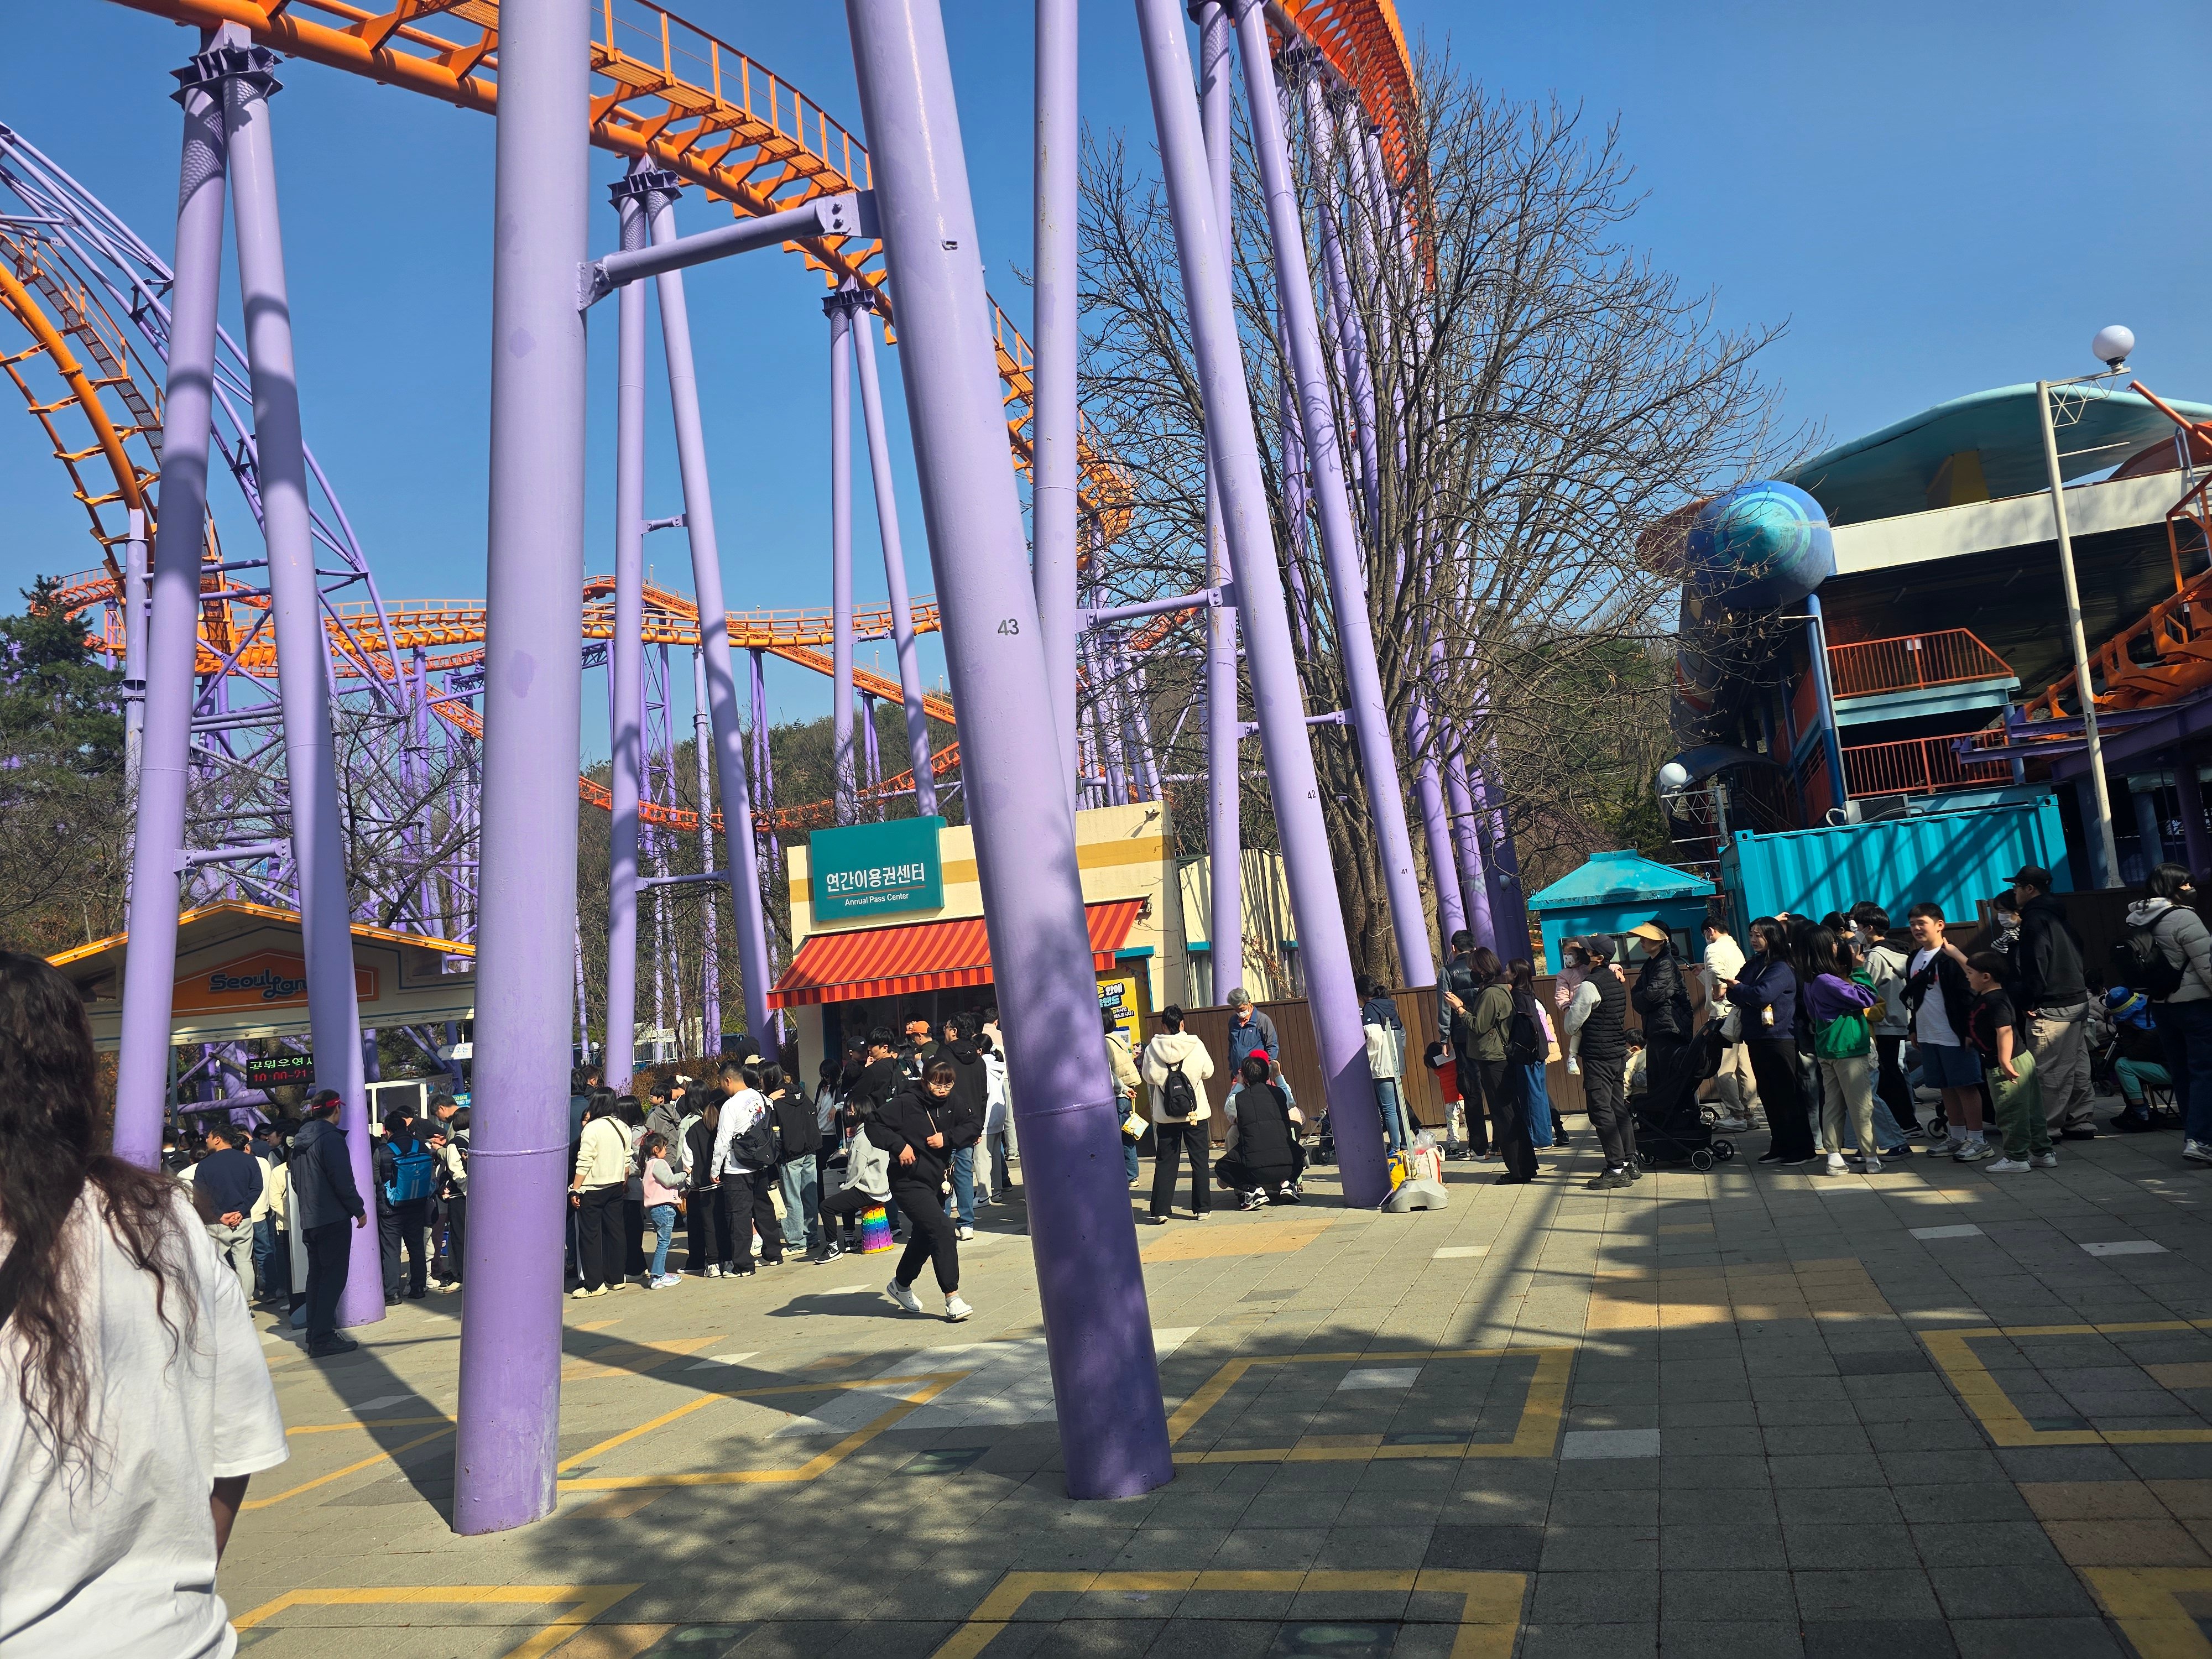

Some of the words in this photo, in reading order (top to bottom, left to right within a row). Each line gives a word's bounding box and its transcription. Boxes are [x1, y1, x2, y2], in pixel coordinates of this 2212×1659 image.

[998, 618, 1019, 635] 43
[1308, 790, 1317, 799] 42
[826, 863, 925, 893] 연간이용권센터
[844, 896, 868, 906] Annual
[887, 893, 910, 901] Center
